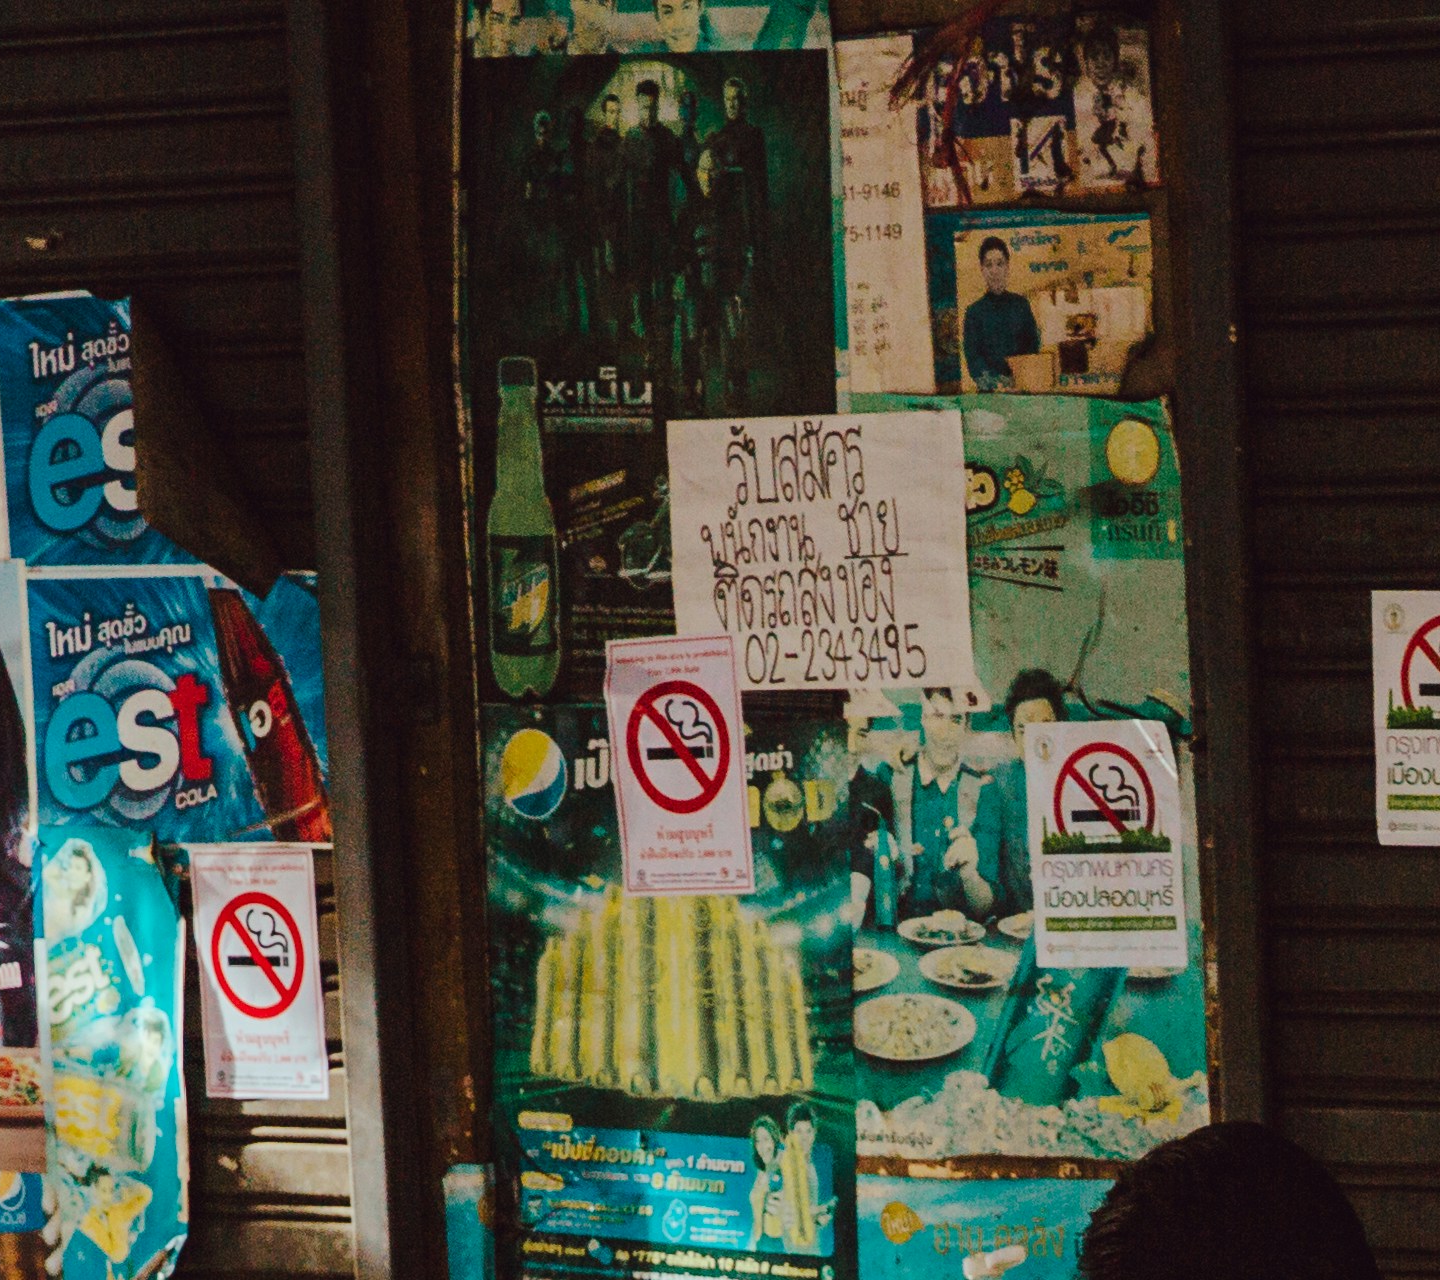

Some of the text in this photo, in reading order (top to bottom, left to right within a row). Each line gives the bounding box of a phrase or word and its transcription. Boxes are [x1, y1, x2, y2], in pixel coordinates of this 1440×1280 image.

[838, 497, 900, 557] ชาย
[46, 612, 92, 658] ใหม่
[745, 622, 927, 685] 02-2343495
[45, 673, 212, 809] est
[175, 783, 218, 810] COLA
[1042, 858, 1174, 883] กรุงเทพมหานคร
[1044, 884, 1174, 912] เมืองปลอดบุหรี่
